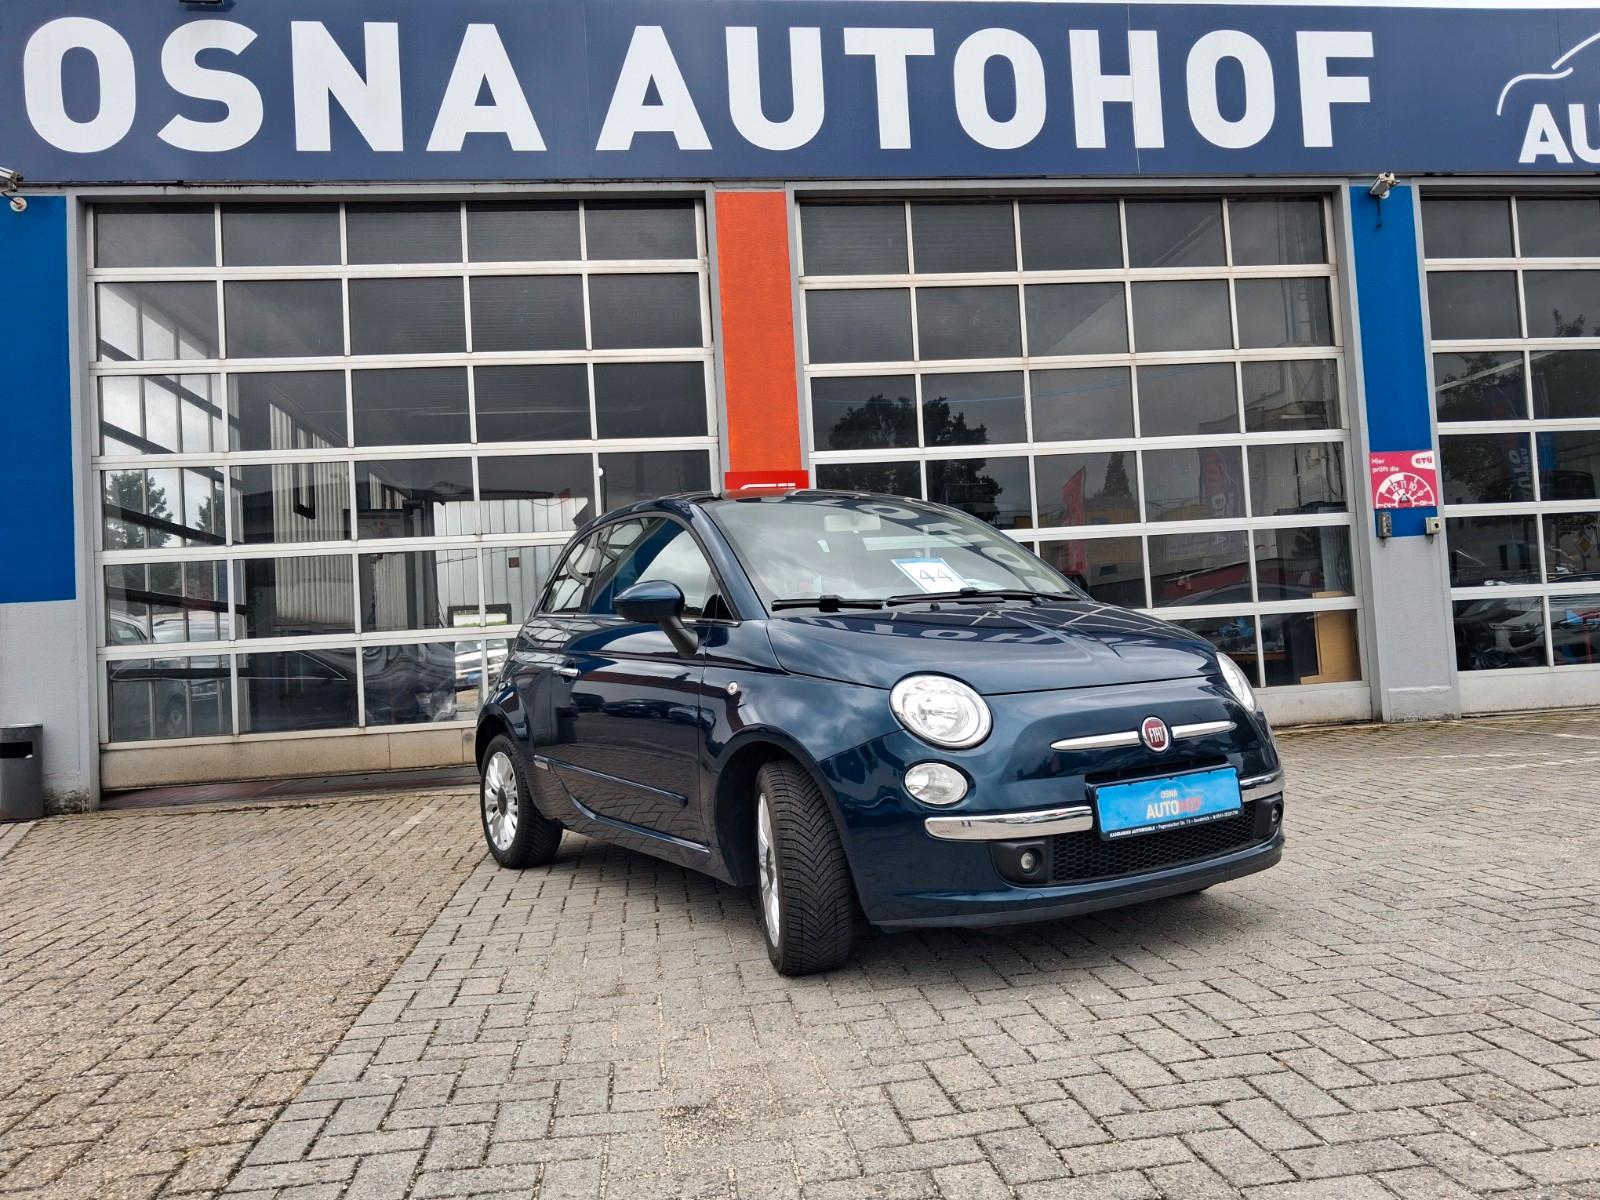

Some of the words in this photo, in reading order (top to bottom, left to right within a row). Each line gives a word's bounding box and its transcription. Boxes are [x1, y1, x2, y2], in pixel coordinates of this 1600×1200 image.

[23, 17, 547, 153] OSNA
[595, 25, 1375, 151] AUTOHOF
[1372, 465, 1389, 474] prüft
[1389, 483, 1399, 492] 12
[1400, 480, 1407, 489] 11
[1408, 481, 1418, 491] 10
[920, 567, 954, 582] 44
[1148, 726, 1165, 743] FIAT
[1160, 789, 1178, 799] OSNA
